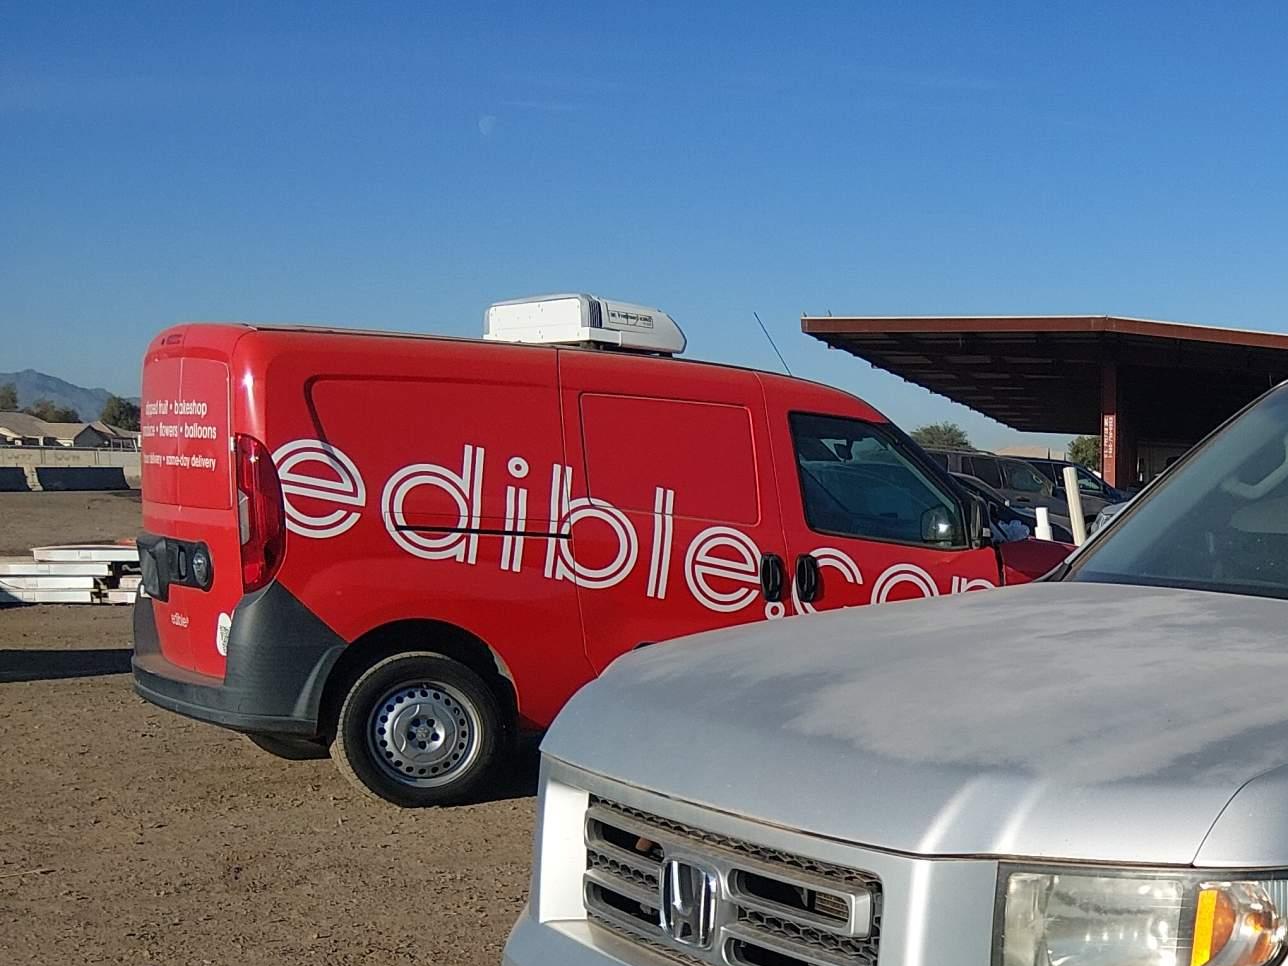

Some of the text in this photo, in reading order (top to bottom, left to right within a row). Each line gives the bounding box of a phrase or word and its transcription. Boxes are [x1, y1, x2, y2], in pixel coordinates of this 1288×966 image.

[173, 400, 208, 419] bakeshop
[184, 422, 217, 440] balloons
[191, 453, 216, 472] delivery
